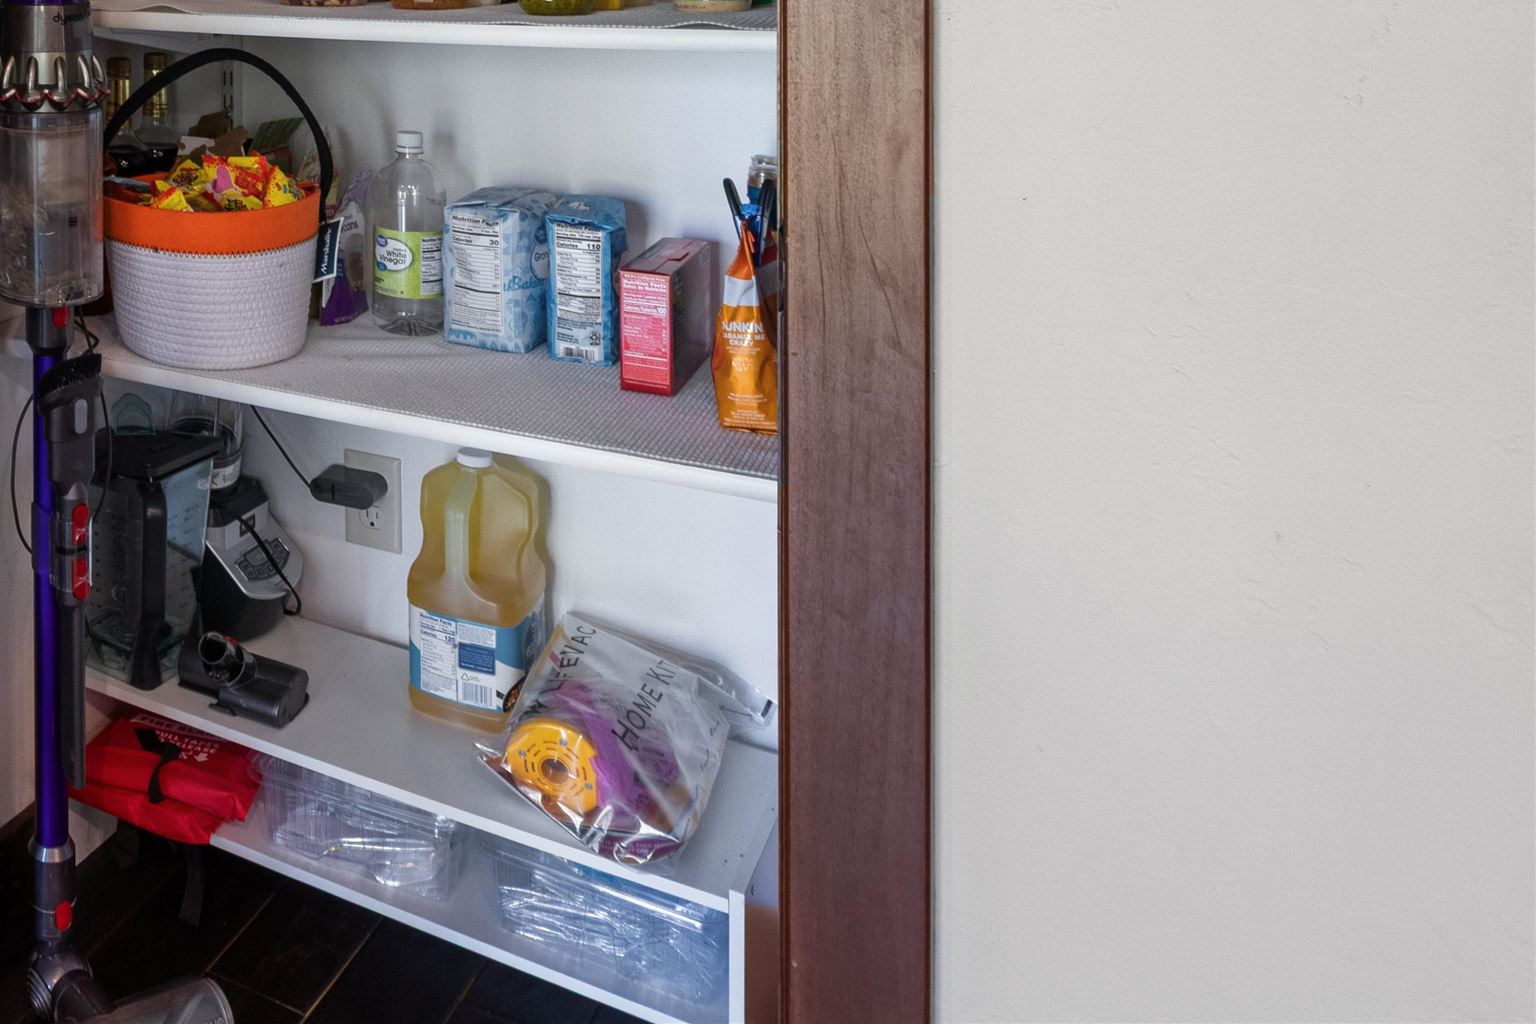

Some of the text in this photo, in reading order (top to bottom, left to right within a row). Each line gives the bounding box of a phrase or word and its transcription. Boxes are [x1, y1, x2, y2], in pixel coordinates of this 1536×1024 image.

[52, 12, 82, 25] dyson
[452, 215, 481, 224] Nutrition
[452, 236, 473, 244] Calories
[386, 250, 407, 258] White
[379, 254, 406, 265] Vinegar
[444, 635, 456, 643] 120
[611, 659, 680, 752] HOME KIT
